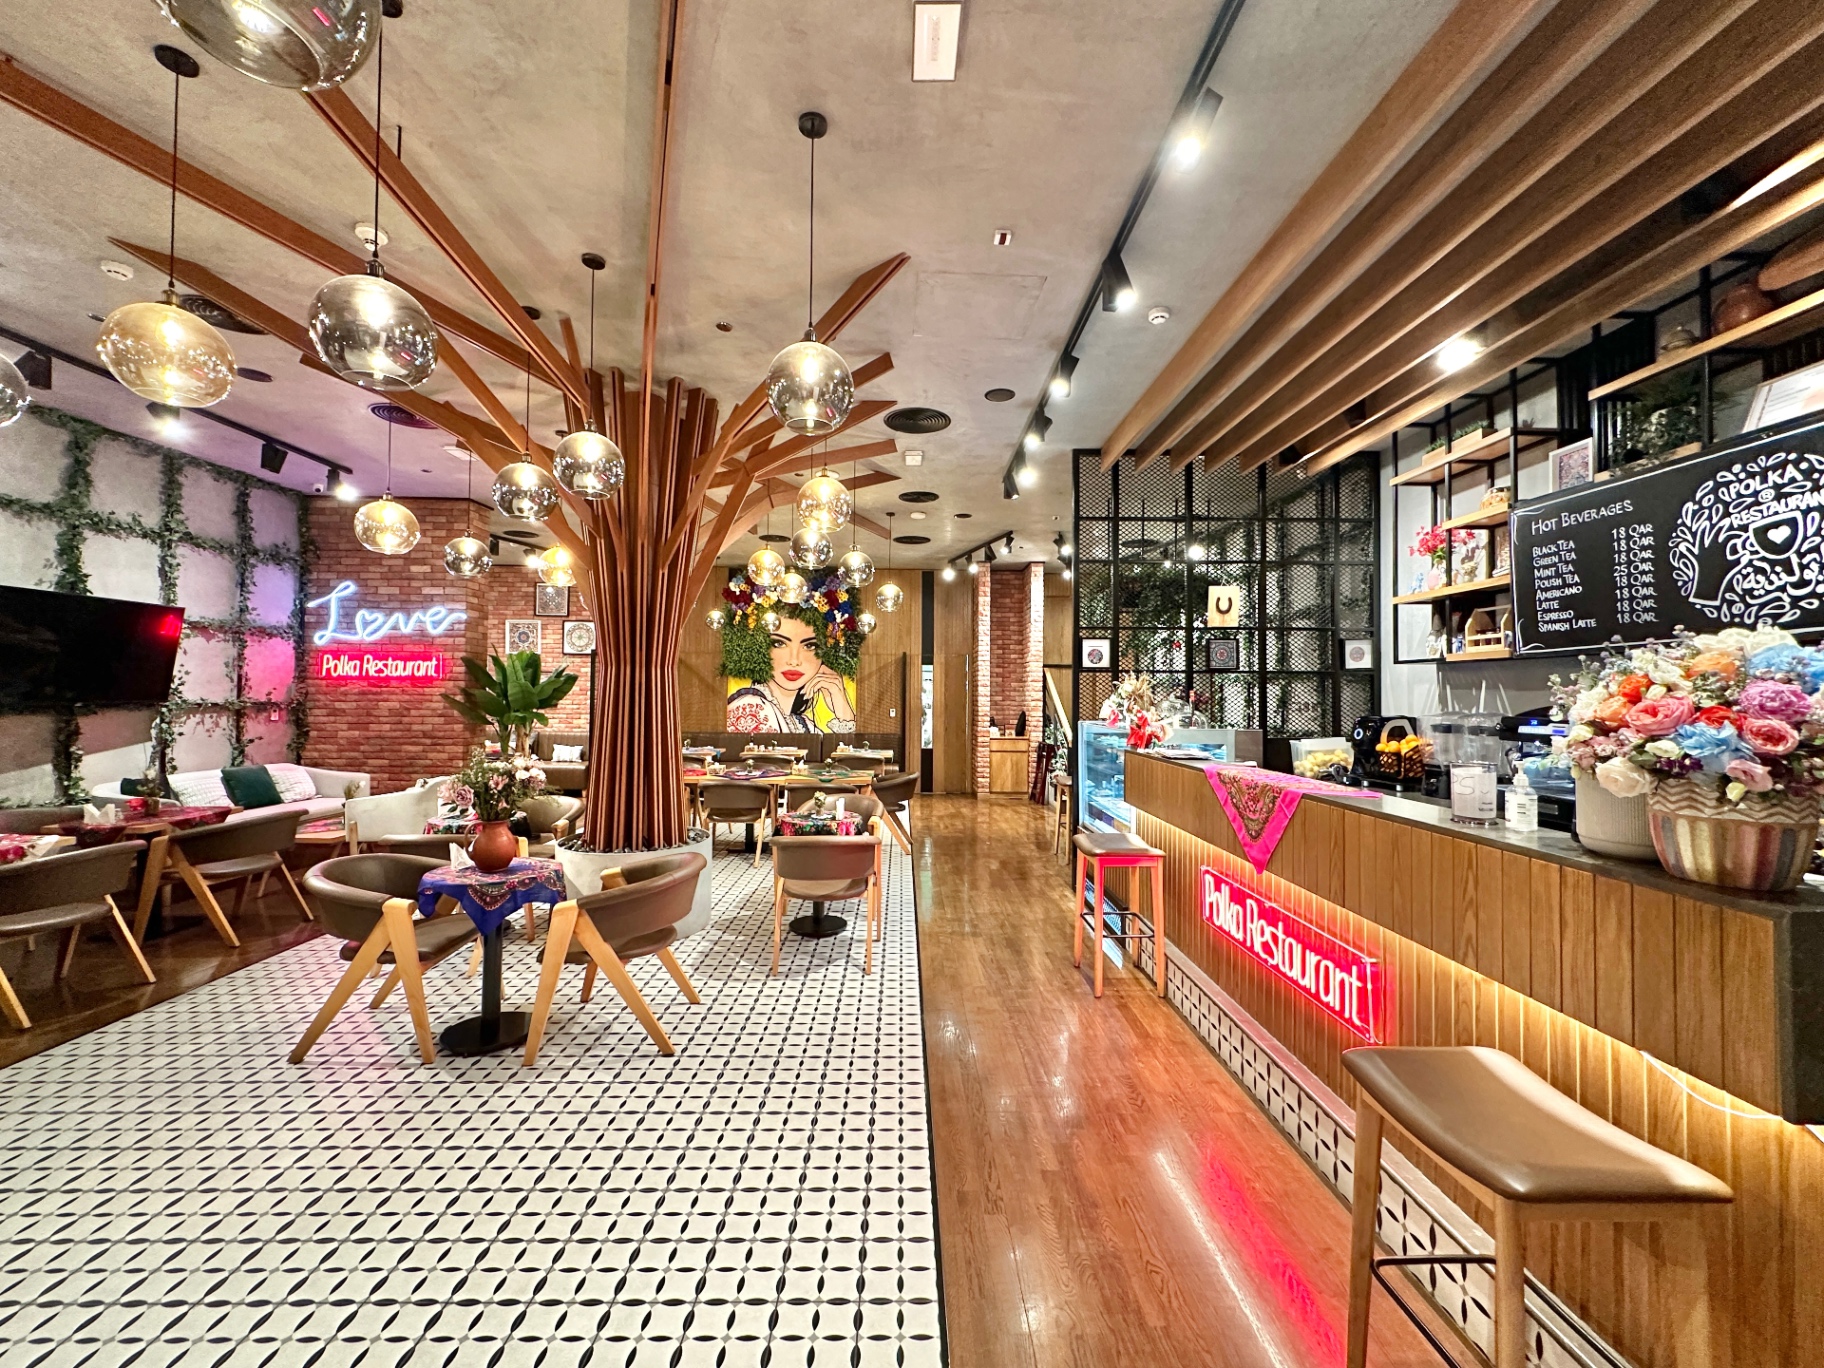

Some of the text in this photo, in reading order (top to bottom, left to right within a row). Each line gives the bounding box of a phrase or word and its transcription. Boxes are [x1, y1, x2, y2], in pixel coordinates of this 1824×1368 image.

[1729, 463, 1804, 500] POLKA
[1531, 500, 1633, 535] HOT BEVERAGES
[1532, 523, 1654, 558] BLACK TEA 18 QAR
[1533, 536, 1655, 567] GREEN TEA 18 QAR
[1534, 550, 1655, 579] MINT TEA 18 QAR
[1563, 574, 1580, 584] TEA
[1613, 565, 1628, 577] 25
[1536, 573, 1655, 600] AMERICANO 18 QAR
[1536, 586, 1658, 611] LATTE 18 QAR
[1537, 598, 1658, 621] ESPRESSO 18 QAR
[1538, 611, 1659, 633] SPANISH LATTE 18 QAR
[322, 654, 438, 677] Polka Restaurant
[1204, 873, 1364, 1026] Polka Restaurant
